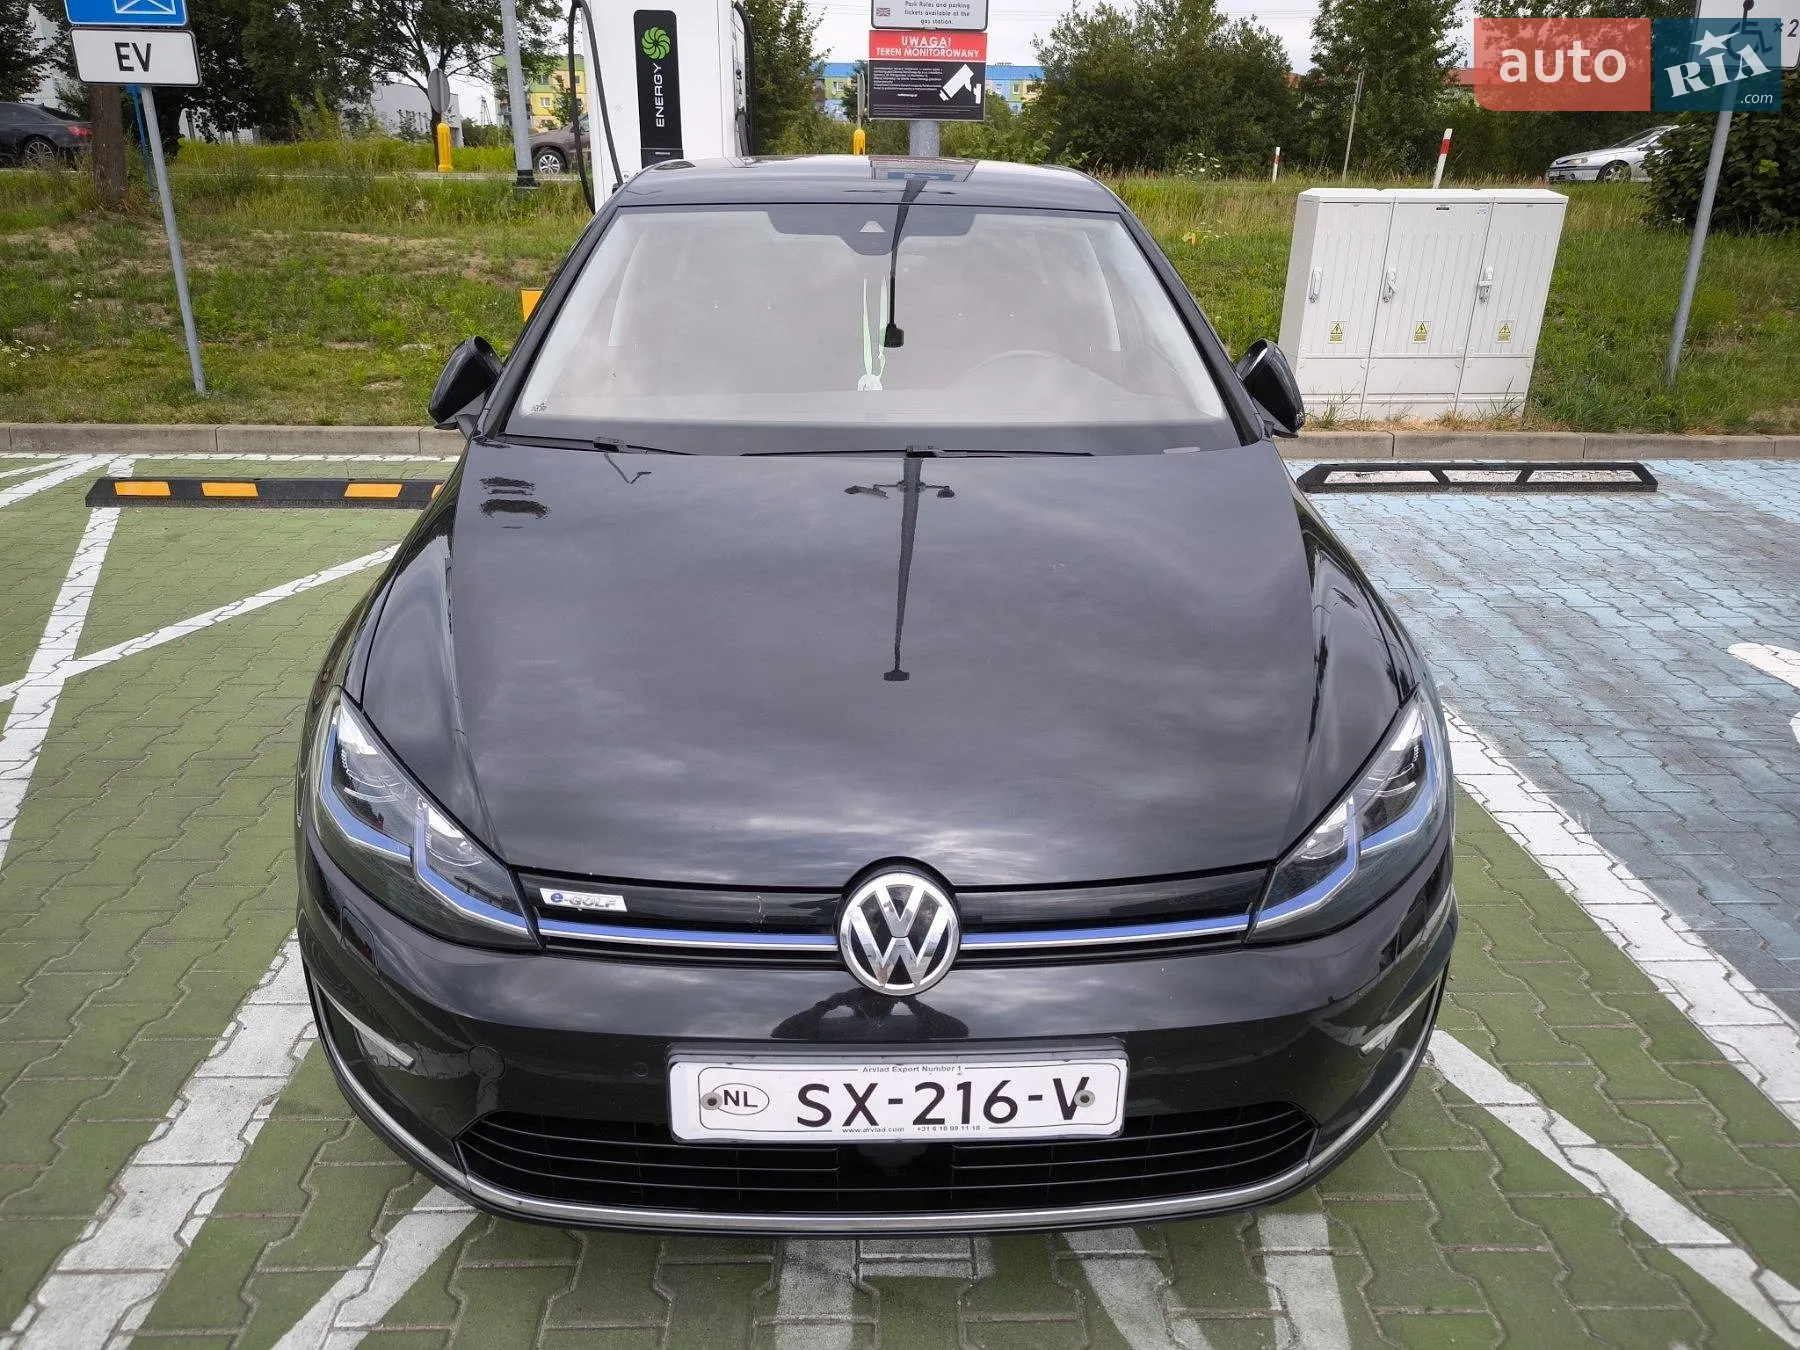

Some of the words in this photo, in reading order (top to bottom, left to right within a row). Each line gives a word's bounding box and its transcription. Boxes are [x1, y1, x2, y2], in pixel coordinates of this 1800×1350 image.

[901, 35, 952, 47] UWAGA!
[115, 42, 152, 72] EV
[876, 47, 901, 56] TEREN
[903, 47, 980, 58] MONITOROWANY
[652, 62, 665, 127] ENERGY
[892, 1066, 920, 1074] Export
[723, 1089, 758, 1109] NL
[796, 1076, 1090, 1128] SX-216-V
